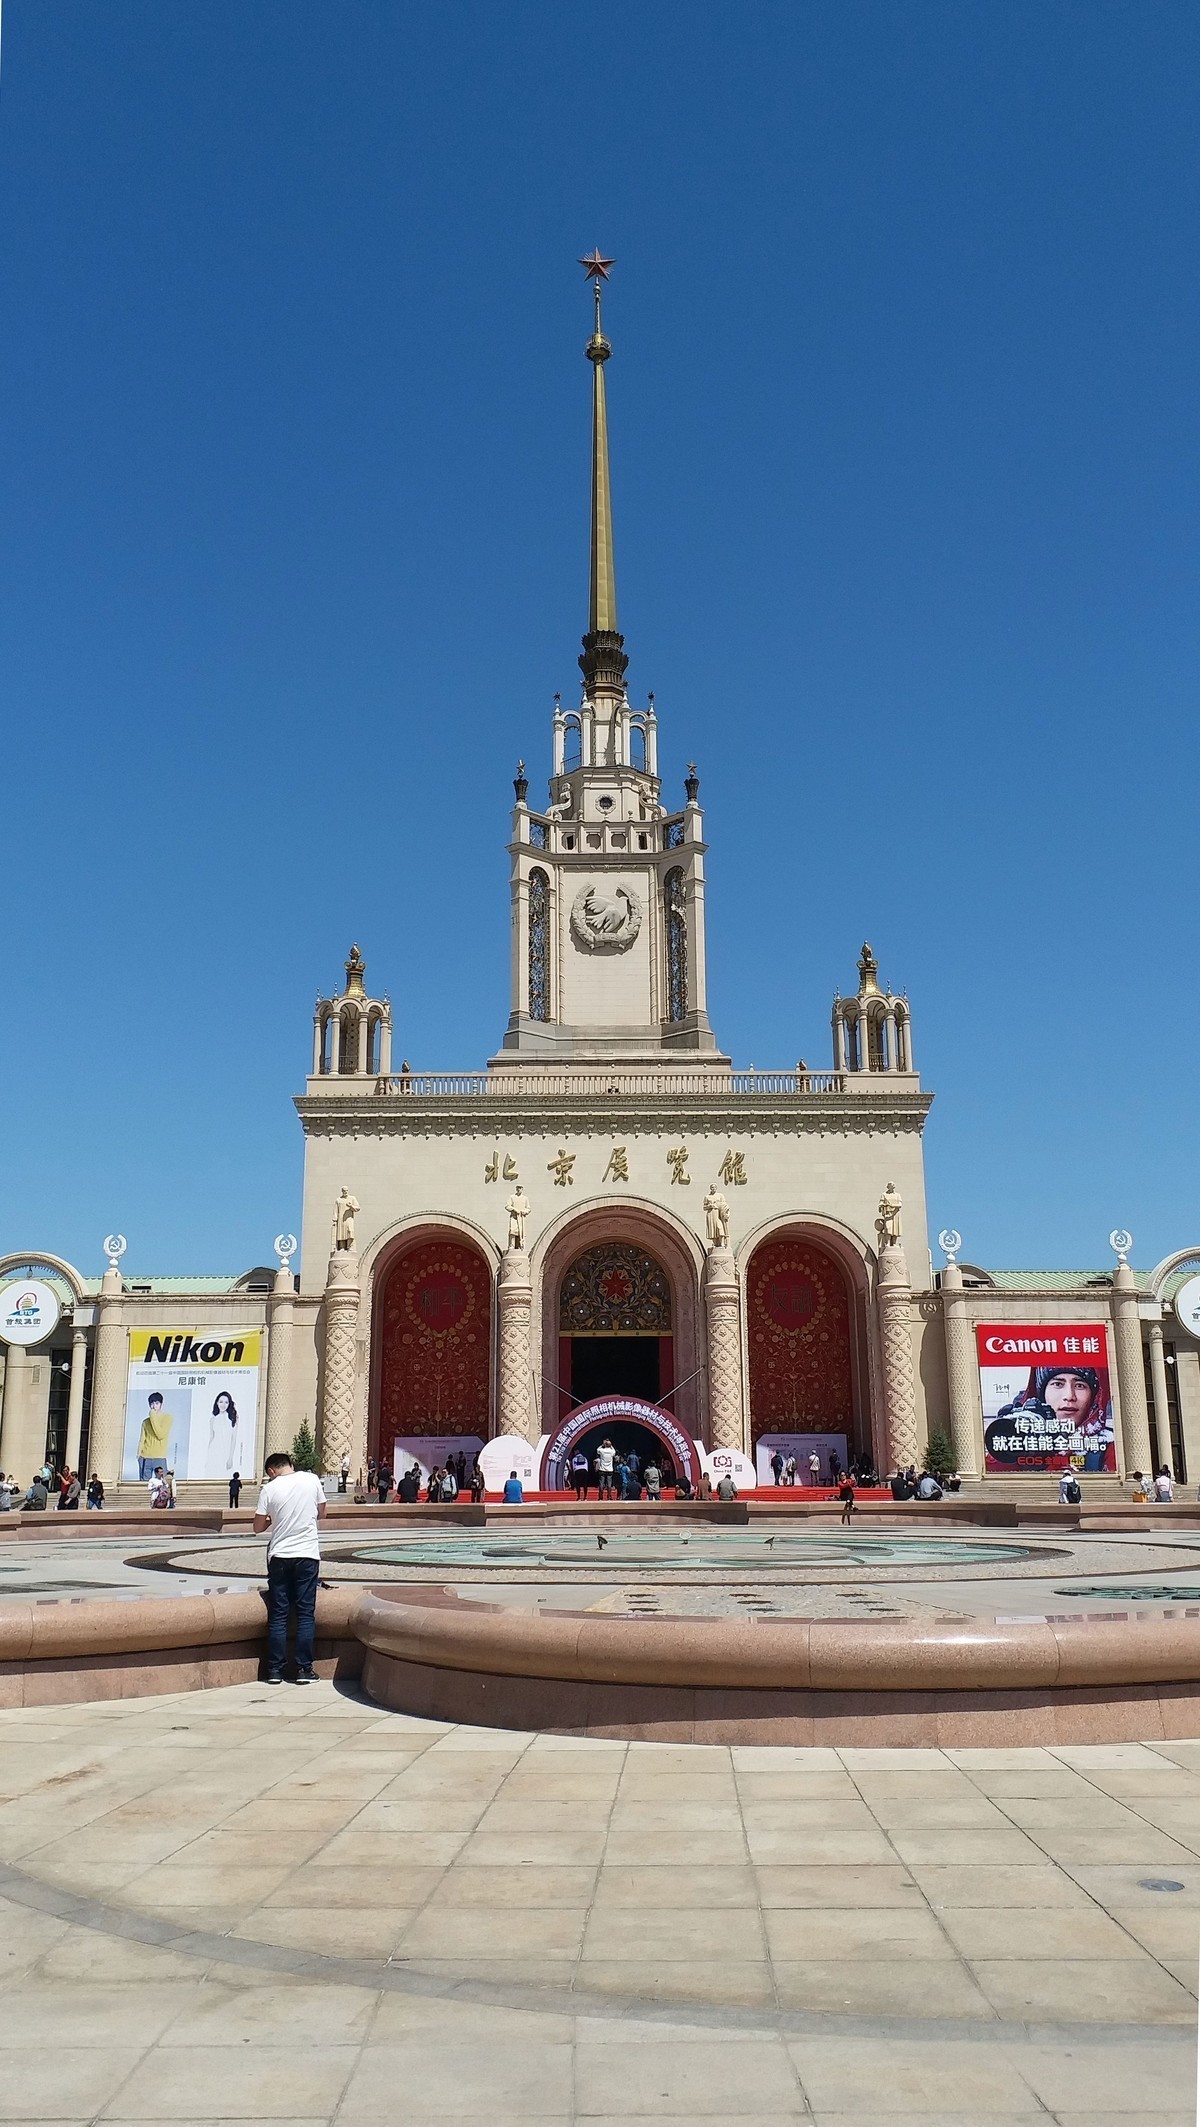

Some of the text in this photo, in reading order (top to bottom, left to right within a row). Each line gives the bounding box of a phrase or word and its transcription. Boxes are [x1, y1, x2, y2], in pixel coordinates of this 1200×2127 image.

[144, 1335, 245, 1362] Nikon
[985, 1337, 1100, 1353] Canon 佳能
[178, 1376, 206, 1385] 尼康馆
[992, 1435, 1106, 1451] 就在佳能全画幅。
[1017, 1456, 1043, 1465] EOS
[1071, 1457, 1083, 1465] 4K
